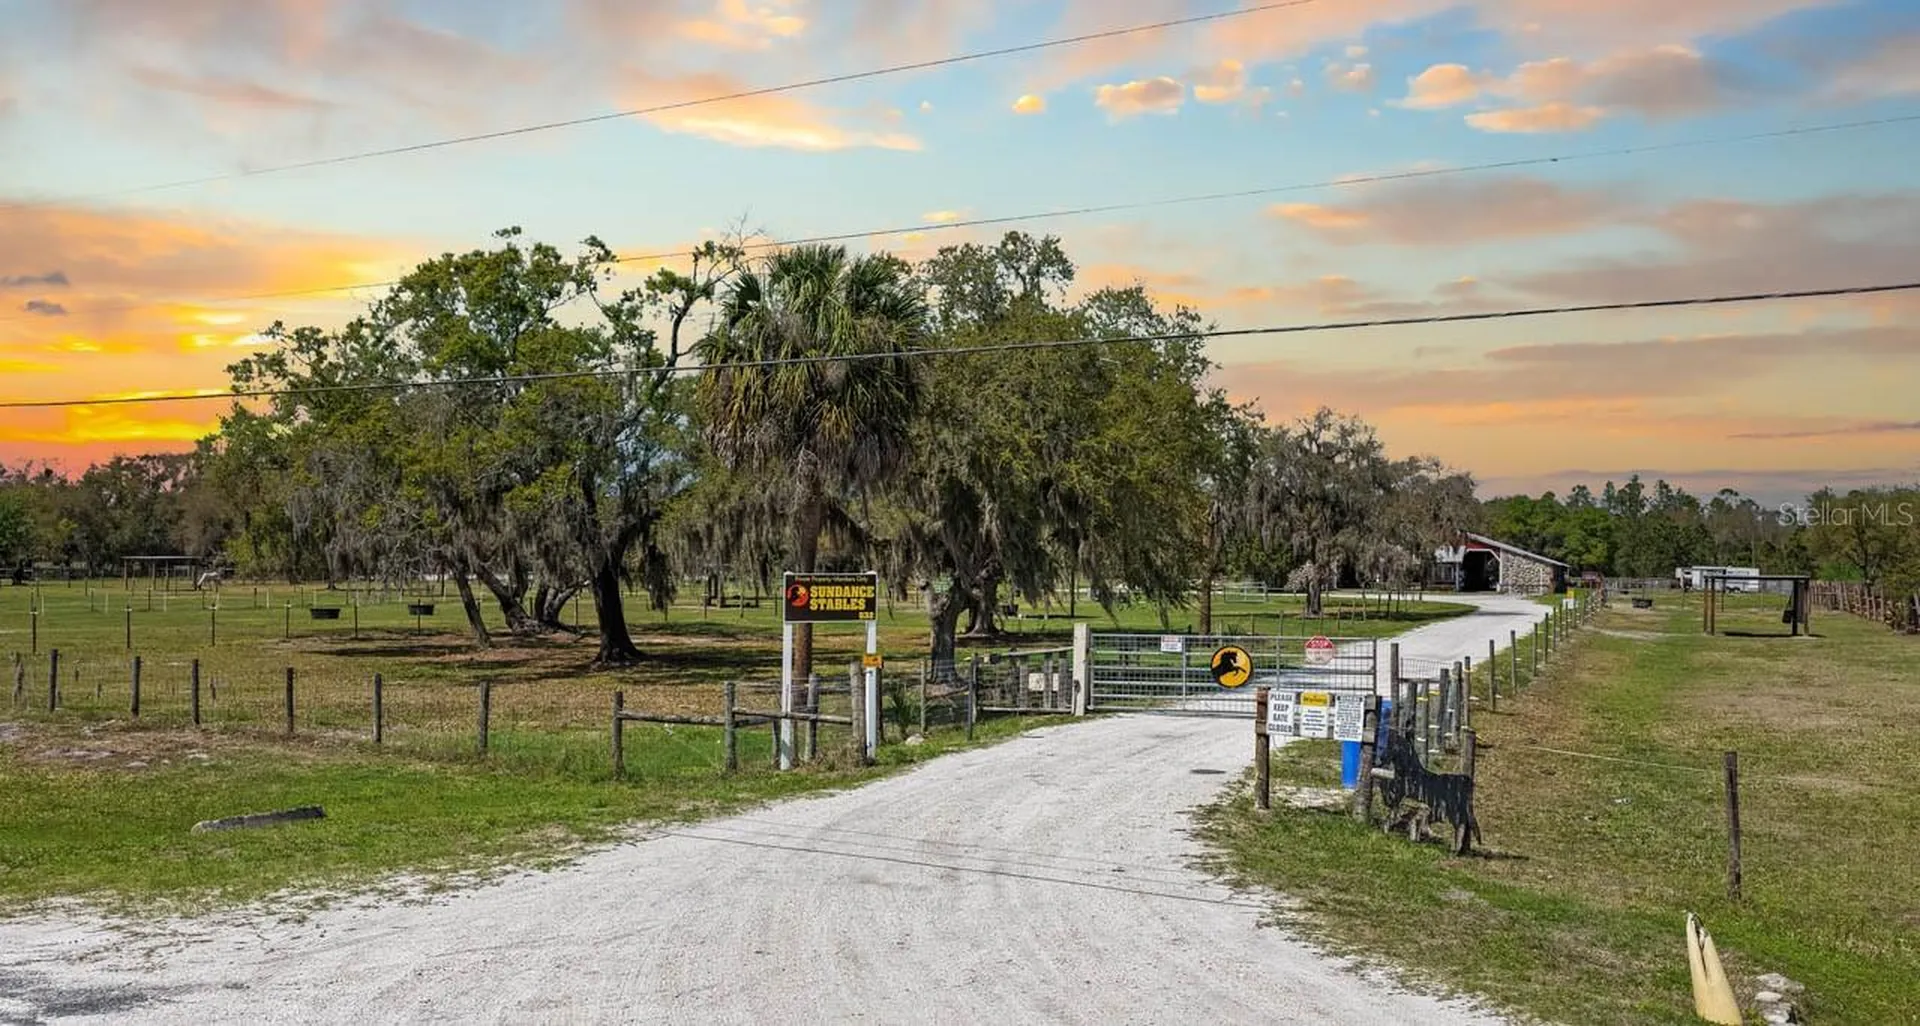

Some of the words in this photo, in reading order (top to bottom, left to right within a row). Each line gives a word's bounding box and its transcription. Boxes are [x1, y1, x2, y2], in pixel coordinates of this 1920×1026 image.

[810, 586, 875, 598] SUNDANCE
[810, 598, 866, 611] STABLES
[1270, 693, 1293, 701] PLEASE
[1273, 703, 1289, 712] KEEP
[1273, 713, 1288, 721] GATE
[1268, 723, 1293, 733] CLOSED
